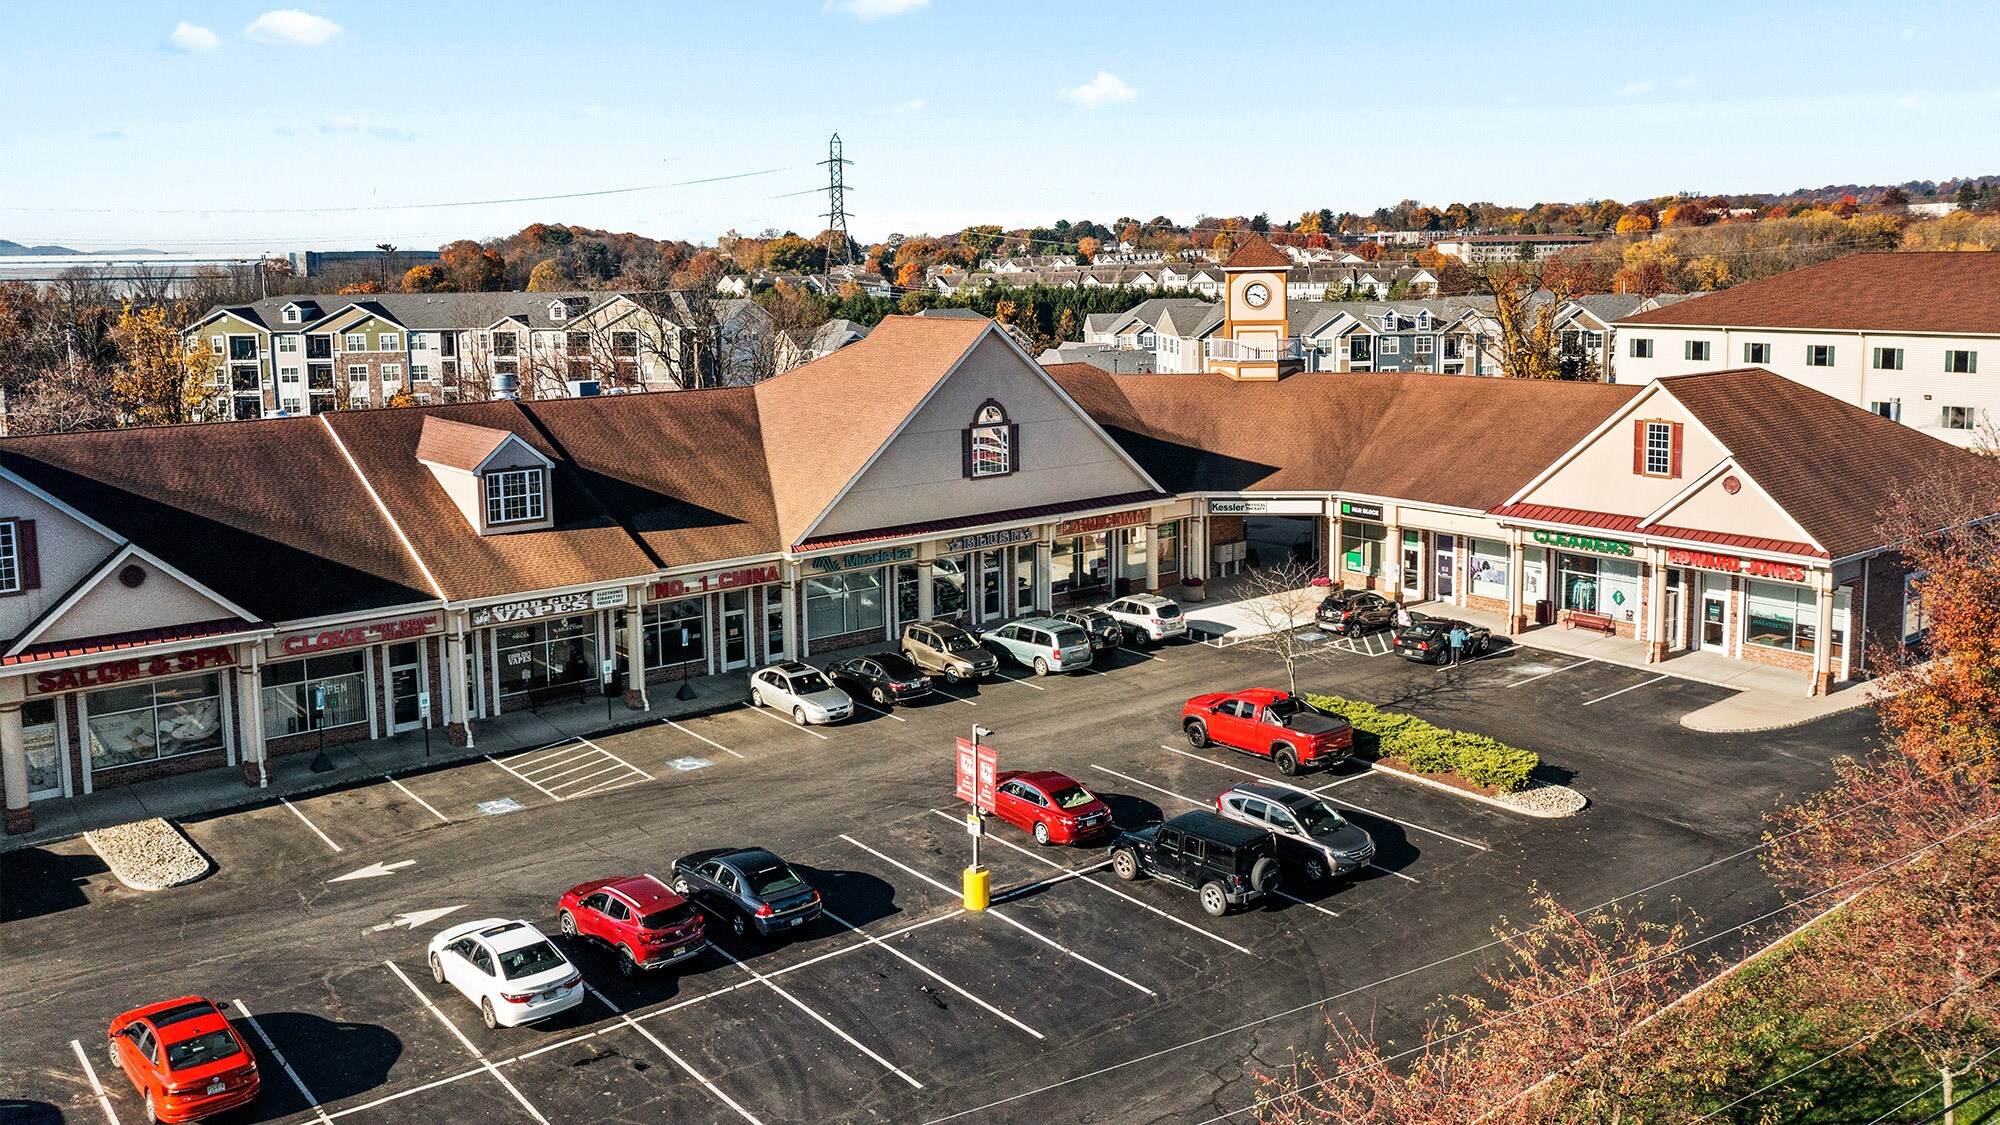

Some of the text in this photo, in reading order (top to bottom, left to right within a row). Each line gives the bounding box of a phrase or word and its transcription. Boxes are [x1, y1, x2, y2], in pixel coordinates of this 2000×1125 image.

[1212, 503, 1245, 511] Kessler
[1363, 508, 1380, 516] BLOCK
[962, 529, 1022, 550] BLUSH
[1533, 530, 1633, 556] CLEANERS
[1667, 548, 1806, 582] EDWARD JONES
[654, 565, 782, 599] NO. 1 CHINA
[492, 593, 588, 614] GOOD GUY
[493, 600, 589, 622] VAPES
[283, 626, 367, 655] CLOVE
[37, 645, 234, 693] SALON & SPA
[508, 655, 532, 666] VAPES
